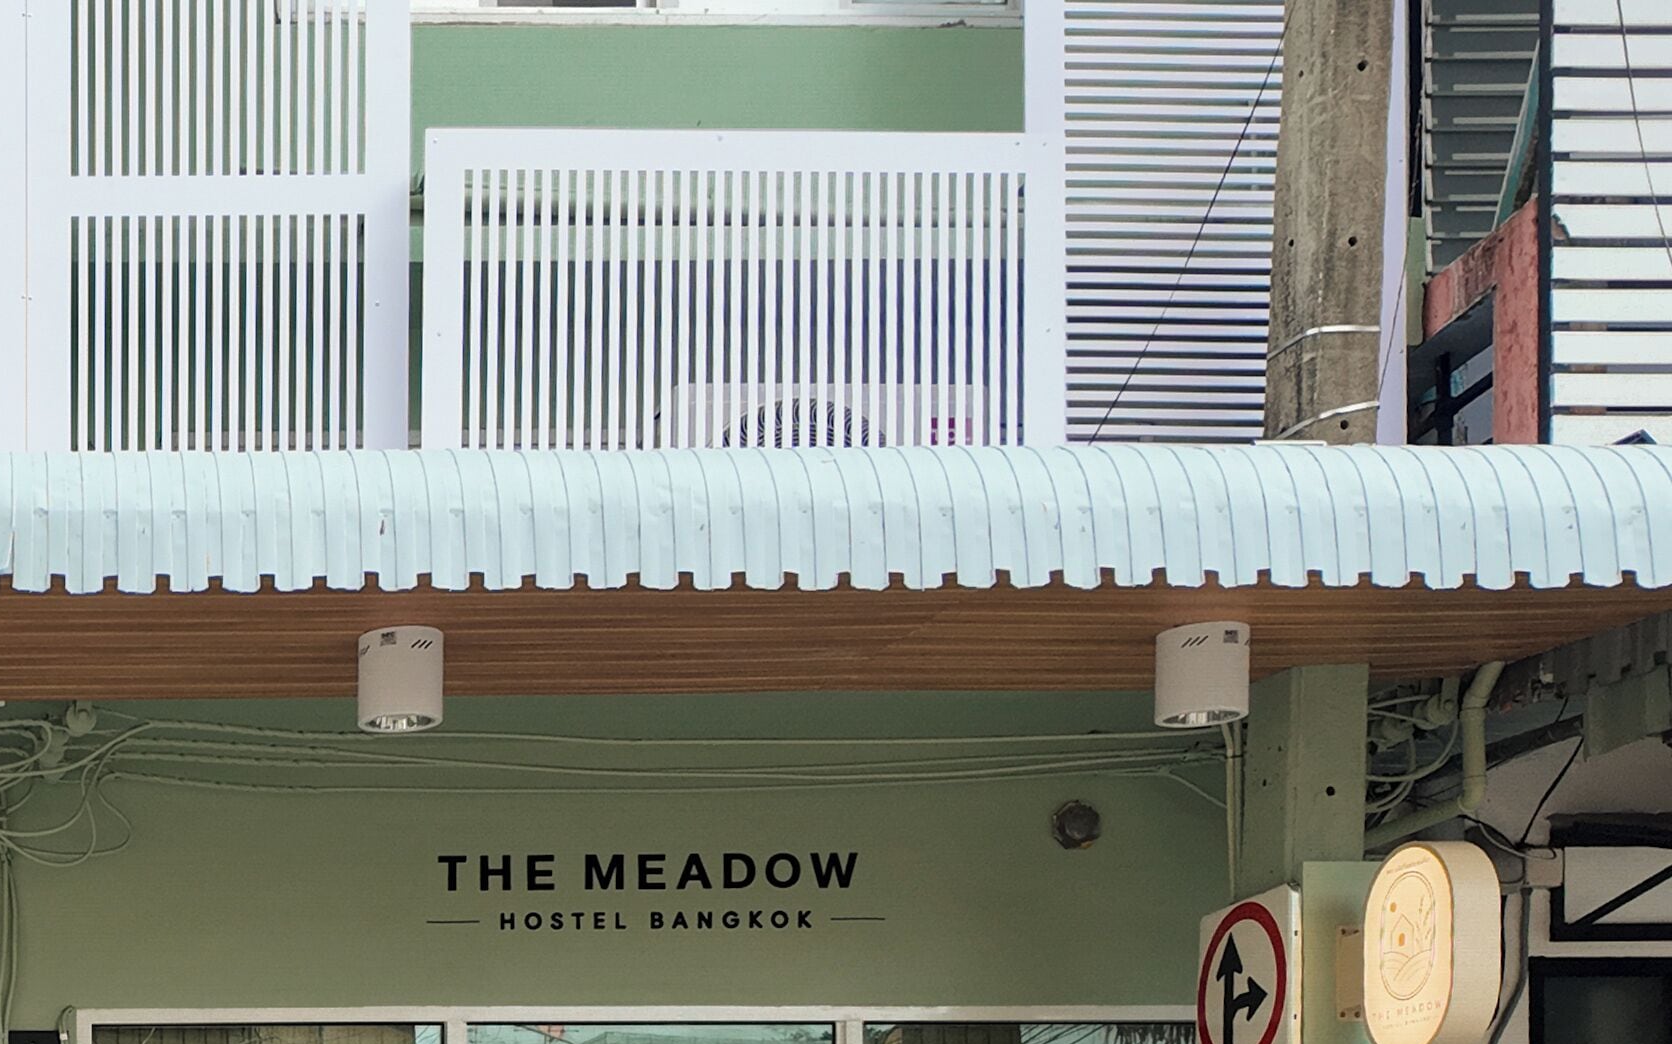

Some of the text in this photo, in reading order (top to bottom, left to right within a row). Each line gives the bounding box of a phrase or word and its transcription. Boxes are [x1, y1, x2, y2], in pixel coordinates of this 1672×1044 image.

[437, 851, 859, 892] THE MEADOW
[499, 910, 814, 931] HOSTEL BANGKOK
[1396, 999, 1443, 1017] MEADOW
